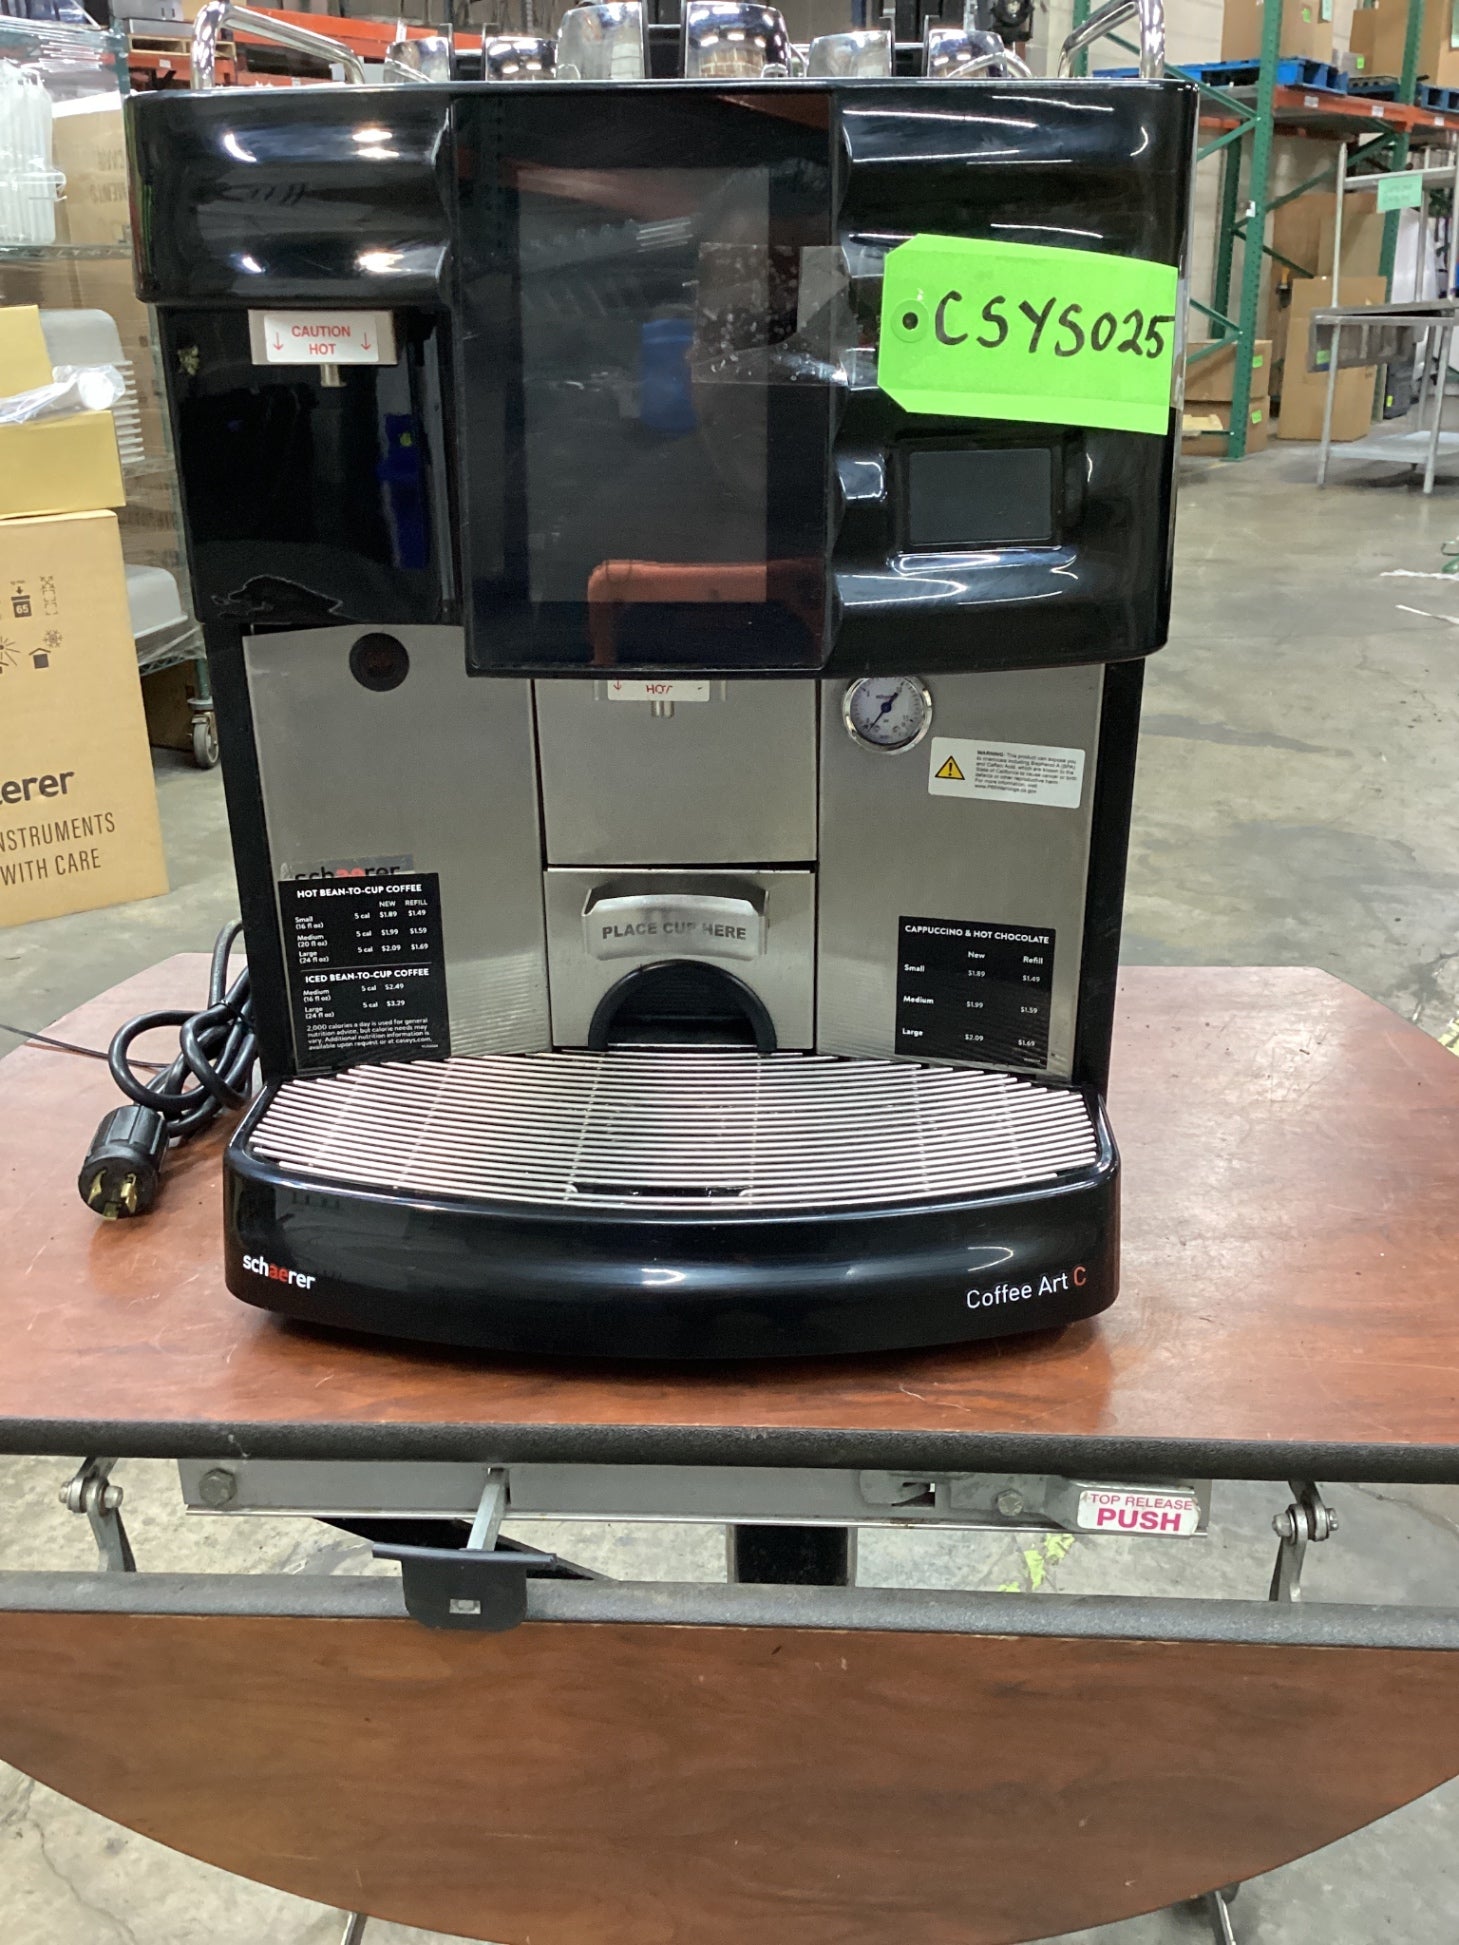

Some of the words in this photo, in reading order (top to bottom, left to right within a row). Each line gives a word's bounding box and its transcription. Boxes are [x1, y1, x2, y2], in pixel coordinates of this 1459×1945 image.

[292, 326, 350, 337] CAUTION
[935, 290, 1175, 358] CSYS025
[310, 344, 336, 355] HOT
[16, 604, 29, 614] 65
[0, 772, 75, 805] erer
[0, 858, 48, 885] WITH
[55, 848, 101, 875] CARE
[297, 890, 317, 898] HOT
[320, 886, 384, 896] BEAN-TO-CUP
[386, 884, 422, 893] COFFEE
[602, 922, 657, 939] PLACE
[663, 922, 696, 934] CUP
[702, 922, 746, 940] HERE
[905, 925, 963, 936] CAPPUCCINO
[994, 932, 1050, 944] CHOCOLATE
[968, 951, 985, 959] New
[1023, 956, 1043, 964] Refill
[305, 975, 327, 983] ICED
[330, 971, 392, 982] BEAN-TO-CUP
[394, 968, 429, 977] COFFEE
[904, 964, 925, 972] Small
[903, 996, 934, 1004] Medium
[902, 1028, 923, 1037] Large
[243, 1255, 316, 1290] schaerer
[967, 1284, 1032, 1308] Coffee
[1038, 1272, 1068, 1296] Art
[1073, 1266, 1087, 1286] C
[1090, 1494, 1120, 1505] TOP
[1125, 1497, 1192, 1510] RELEASE
[1097, 1508, 1182, 1532] PUSH
